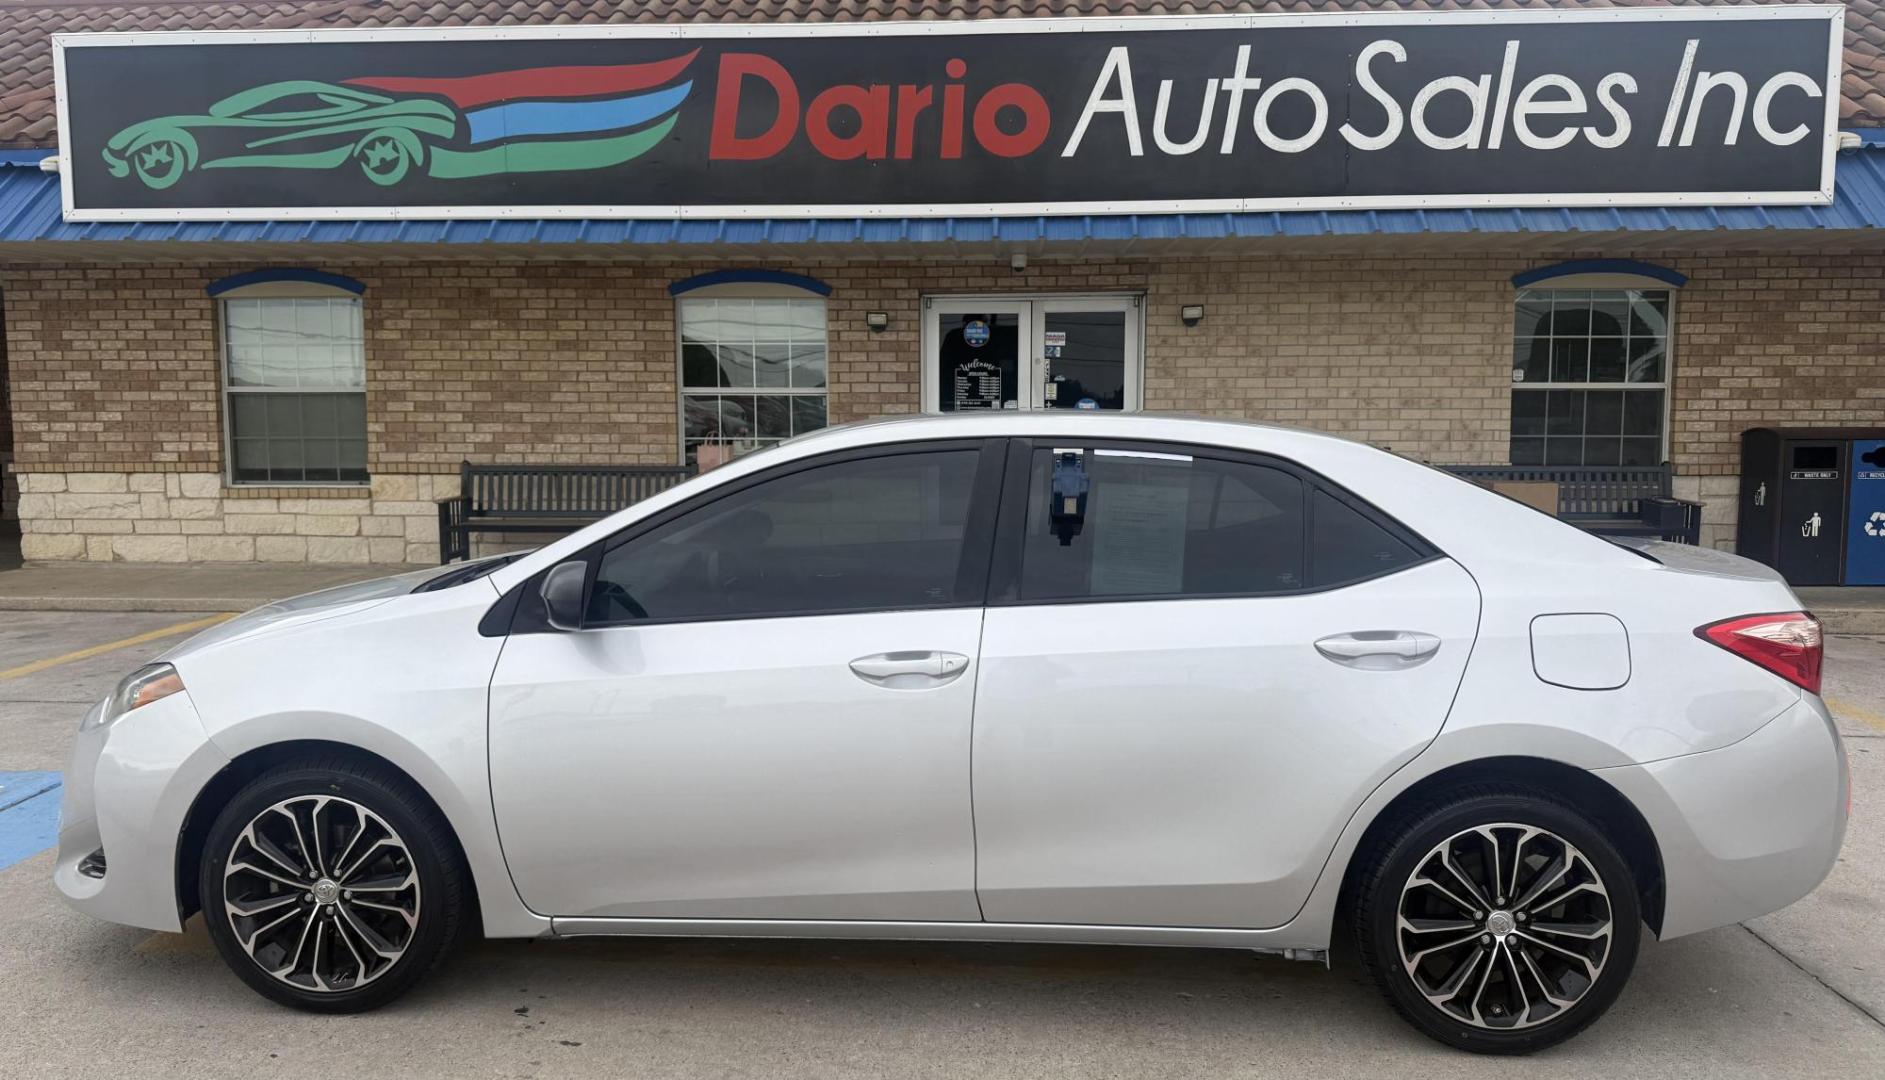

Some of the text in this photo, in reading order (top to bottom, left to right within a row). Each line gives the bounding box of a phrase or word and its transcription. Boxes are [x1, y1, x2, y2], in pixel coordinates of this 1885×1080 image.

[709, 39, 1822, 160] Dario Auto Sales Inc
[960, 358, 995, 372] Welcome
